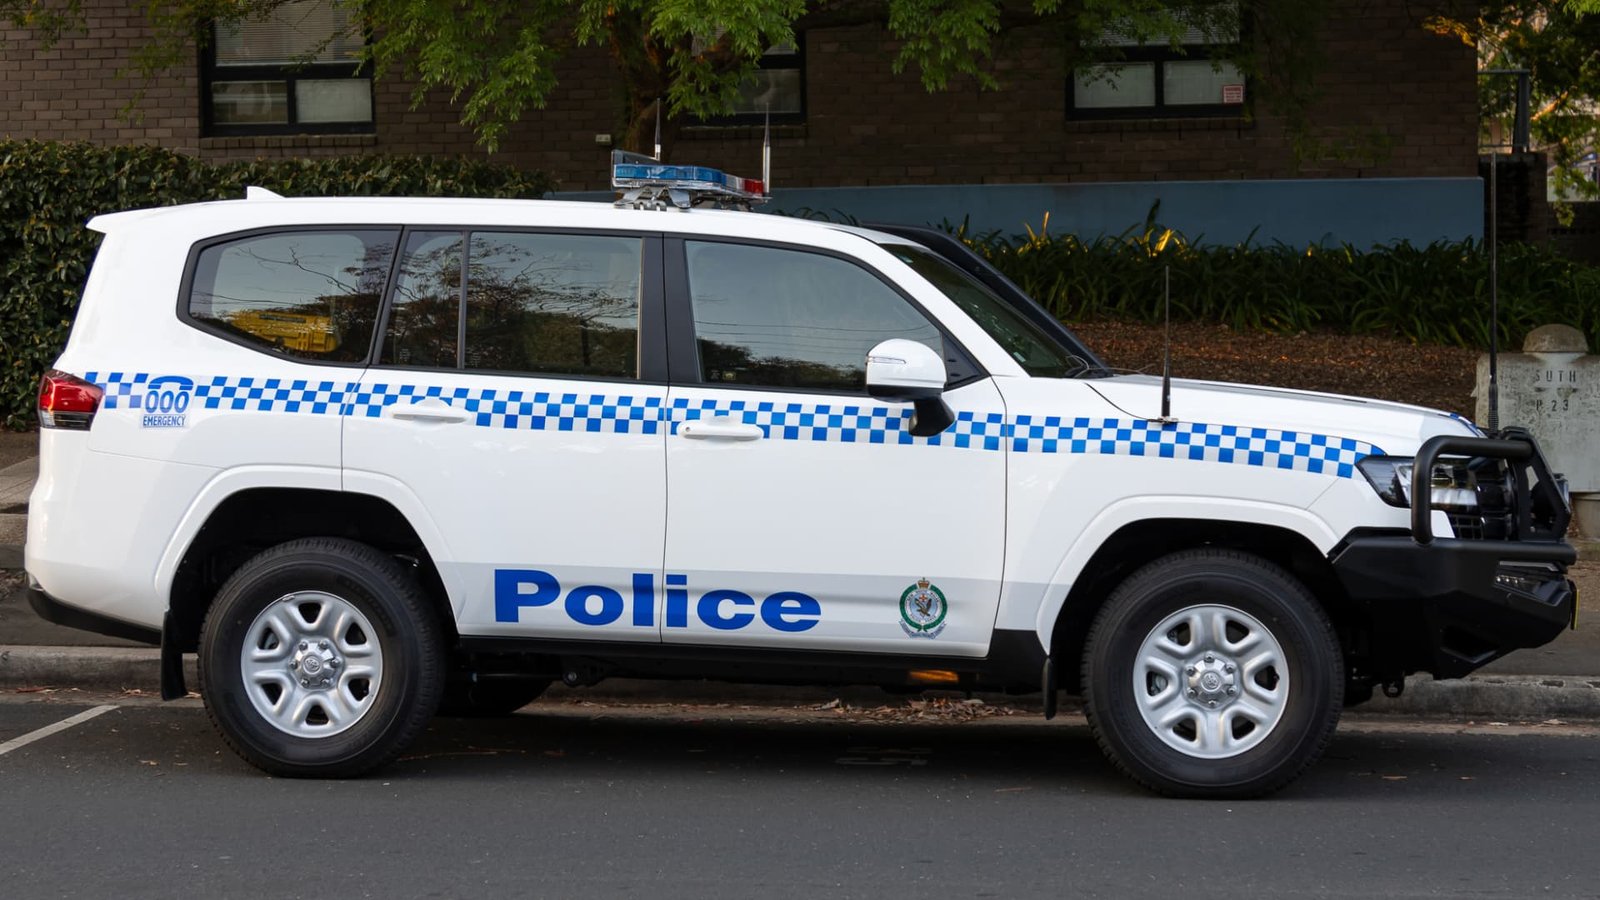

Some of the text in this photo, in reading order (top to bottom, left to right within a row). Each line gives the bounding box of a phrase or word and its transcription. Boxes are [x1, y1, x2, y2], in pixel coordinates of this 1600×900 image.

[1535, 369, 1577, 383] SUTH
[145, 390, 190, 413] 000
[142, 415, 186, 427] EMERGENCY
[494, 569, 821, 632] Police
